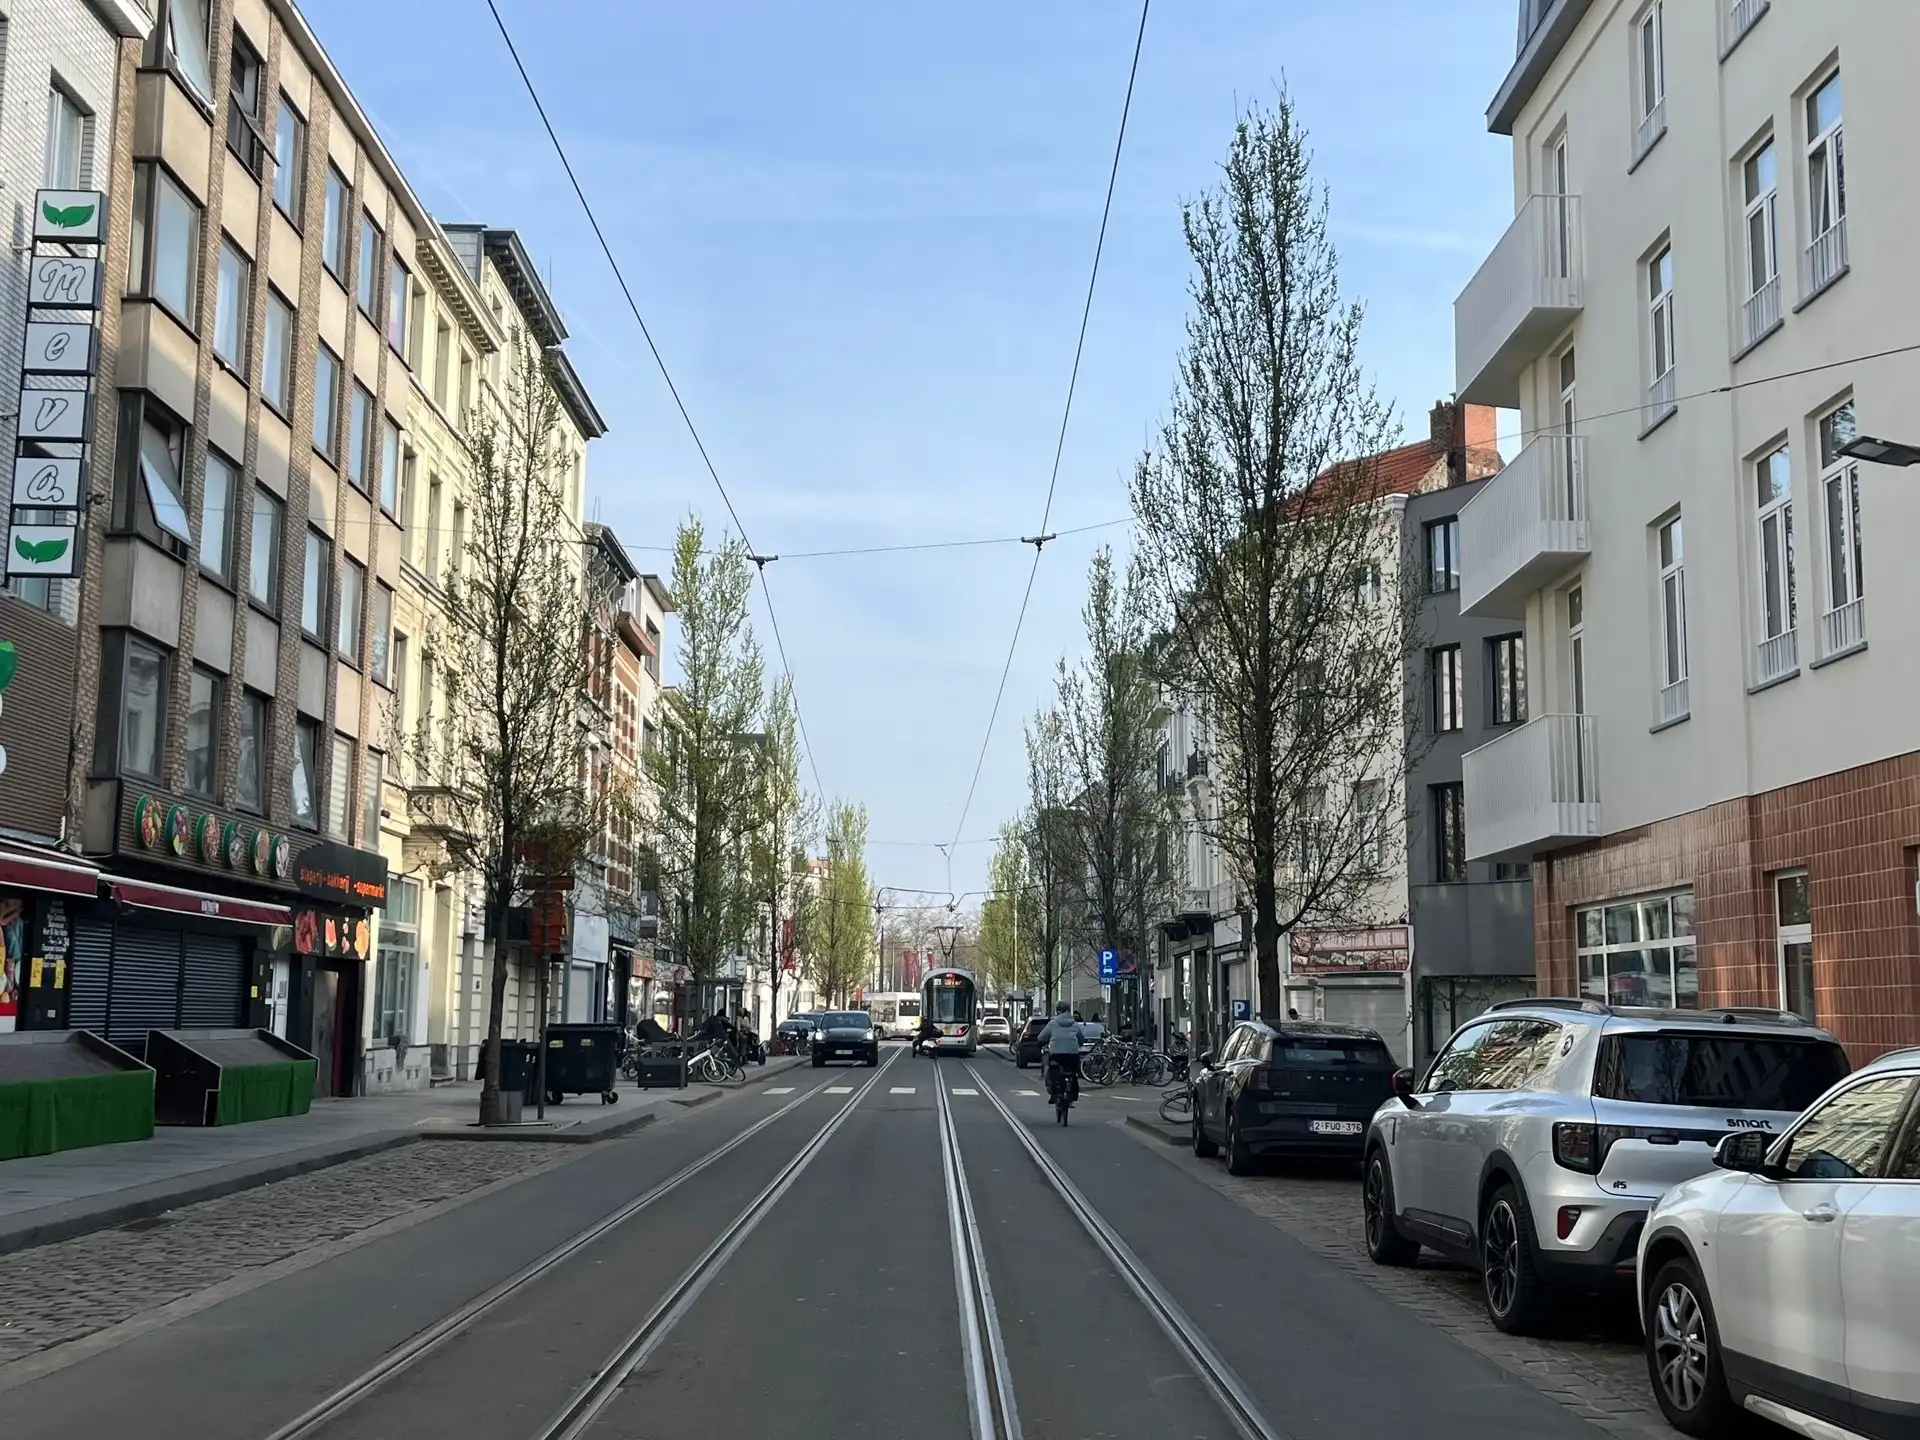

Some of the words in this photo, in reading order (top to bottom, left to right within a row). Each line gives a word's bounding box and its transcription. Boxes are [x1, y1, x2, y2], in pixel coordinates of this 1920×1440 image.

[1103, 951, 1113, 965] P
[1234, 1001, 1246, 1017] P
[1726, 1118, 1772, 1130] smart
[1612, 1180, 1627, 1189] #5
